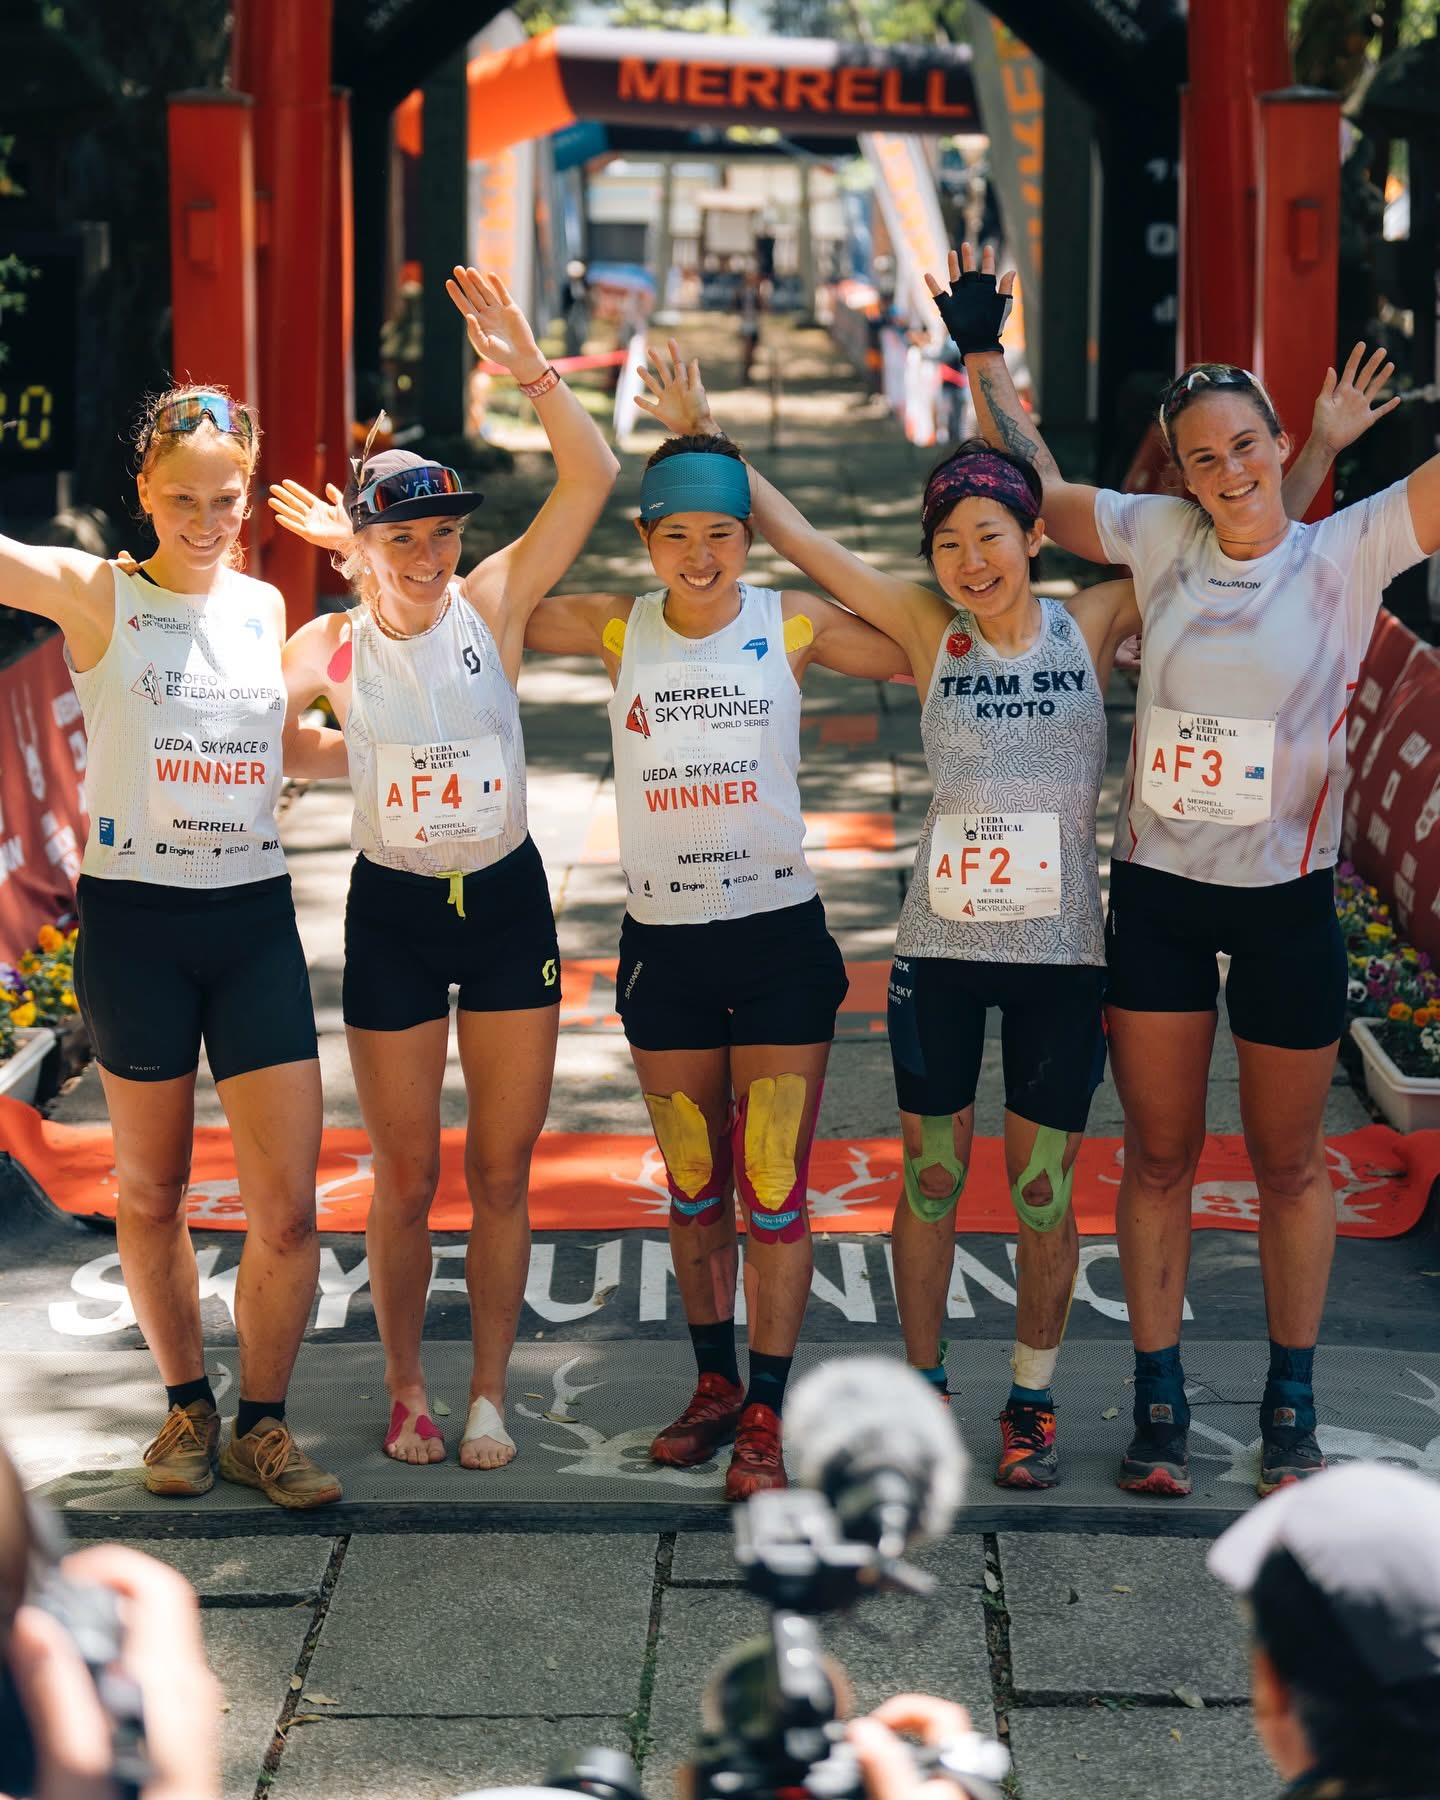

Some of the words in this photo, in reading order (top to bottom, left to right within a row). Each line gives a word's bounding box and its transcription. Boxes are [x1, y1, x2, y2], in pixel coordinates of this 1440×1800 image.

[618, 57, 970, 117] MERRELL
[1208, 578, 1261, 590] SALOMON
[165, 670, 218, 686] TROFEO
[940, 674, 1020, 697] TEAM
[1032, 670, 1086, 693] SKY
[166, 684, 226, 700] ESTEBAN
[655, 685, 745, 703] MERRELL
[976, 700, 1055, 719] KYOTO
[711, 720, 742, 730] WORLD
[743, 718, 770, 728] SERIES
[1196, 717, 1219, 727] UEDA
[1196, 725, 1238, 737] VERTICAL
[154, 737, 193, 752] UEDA
[1196, 734, 1218, 743] RACE
[429, 744, 453, 753] UEDA
[430, 749, 471, 761] VERTICAL
[430, 760, 454, 770] RACE
[156, 758, 266, 785] WINNER
[642, 767, 678, 782] UEDA
[645, 780, 759, 812] WINNER
[1187, 797, 1224, 807] MERRELL
[172, 818, 247, 833] MERRELL
[981, 816, 1004, 824] UEDA
[429, 822, 467, 831] MERRELL
[981, 824, 1024, 832] VERTICAL
[981, 833, 1004, 841] RACE
[225, 844, 249, 854] NEDAO
[262, 839, 279, 850] BIX
[169, 846, 195, 856] Engine
[677, 849, 751, 864] MERRELL
[733, 873, 759, 884] NEDAO
[775, 866, 794, 879] BIX
[682, 882, 705, 891] Engine
[624, 960, 643, 1000] SALOMON
